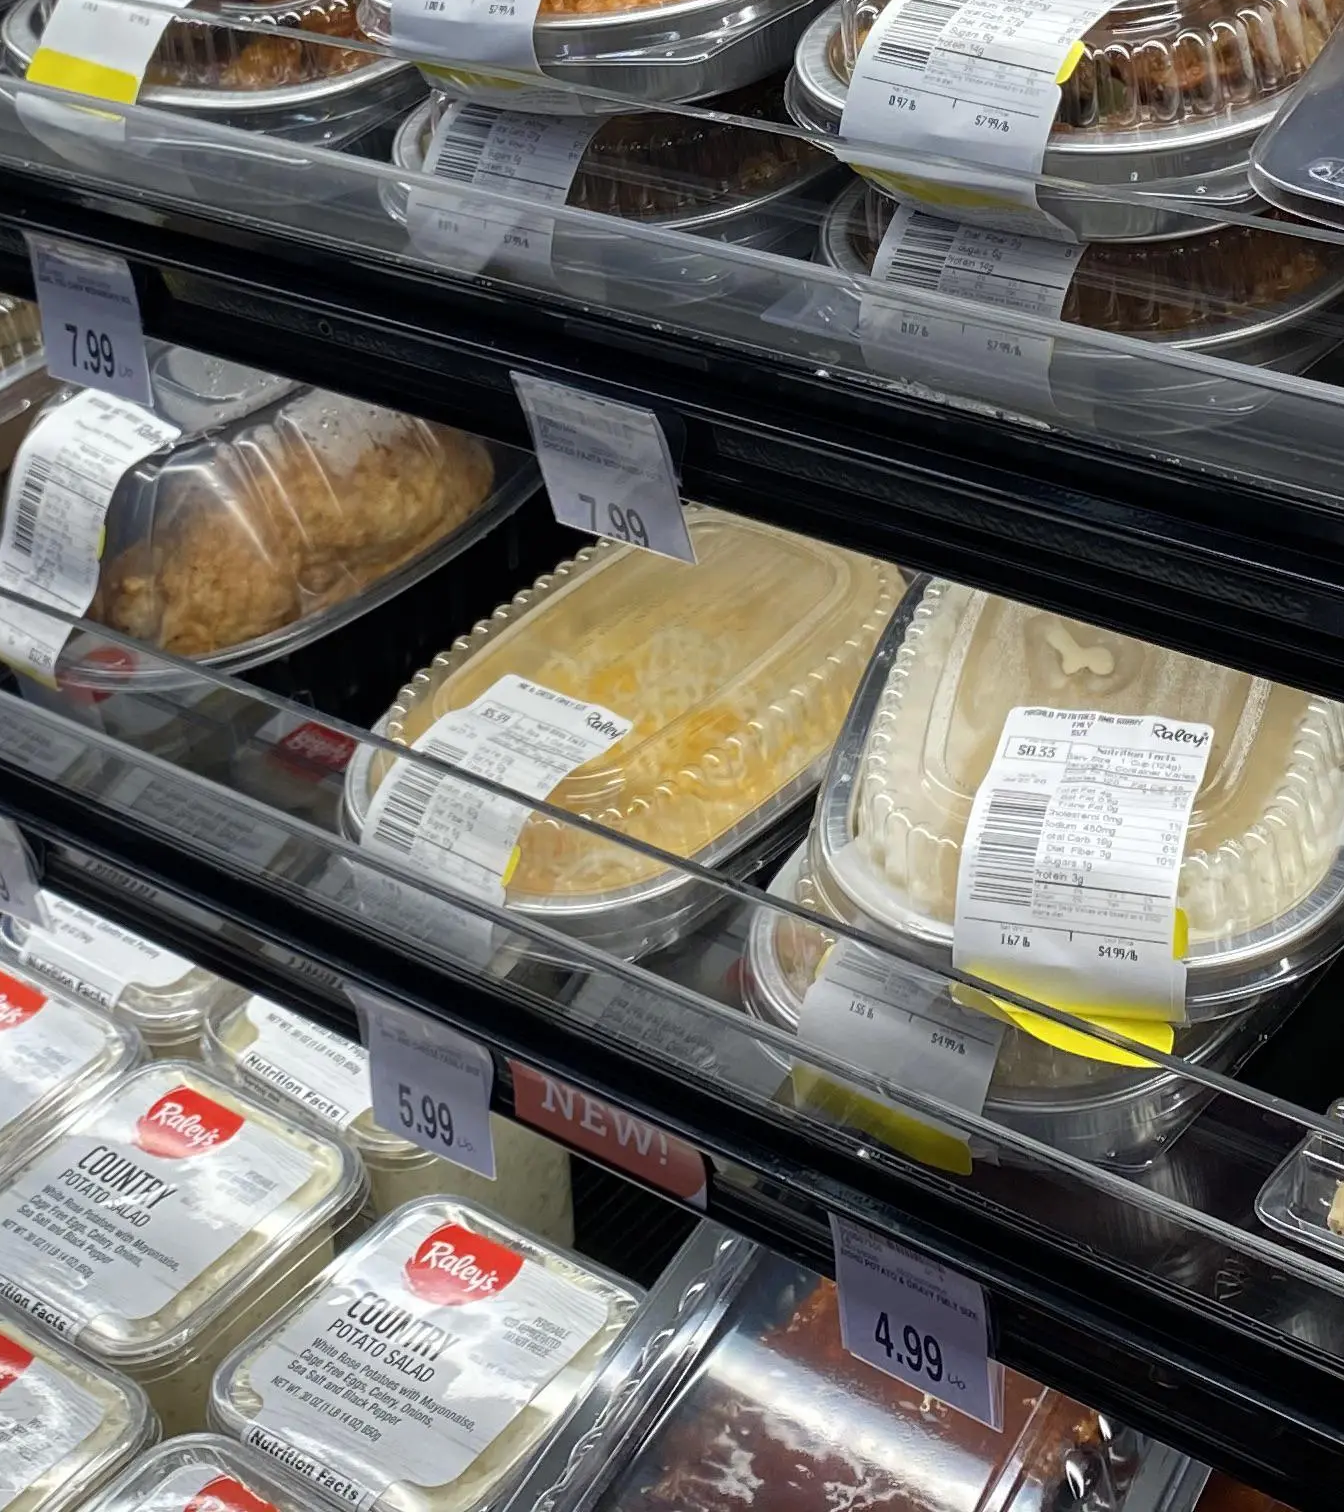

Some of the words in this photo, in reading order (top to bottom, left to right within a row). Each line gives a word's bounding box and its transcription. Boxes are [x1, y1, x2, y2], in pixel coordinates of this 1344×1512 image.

[64, 323, 116, 378] 7.99
[151, 1101, 220, 1149] Raley's
[396, 1081, 455, 1148] 5.99
[537, 1075, 671, 1167] NEW!
[78, 1145, 177, 1210] COUNTRY
[420, 1240, 499, 1293] Raley's
[28, 1300, 68, 1333] Facts
[346, 1291, 461, 1361] COUNTRY
[875, 1312, 943, 1382] 4.99
[310, 1338, 339, 1362] White
[337, 1353, 365, 1376] Rose
[360, 1364, 403, 1397] Potatoes
[399, 1383, 423, 1405] with
[327, 1318, 386, 1363] POTATO
[383, 1348, 436, 1382] SALAD
[249, 1430, 316, 1478] Nutrition
[315, 1467, 361, 1502] Facts
